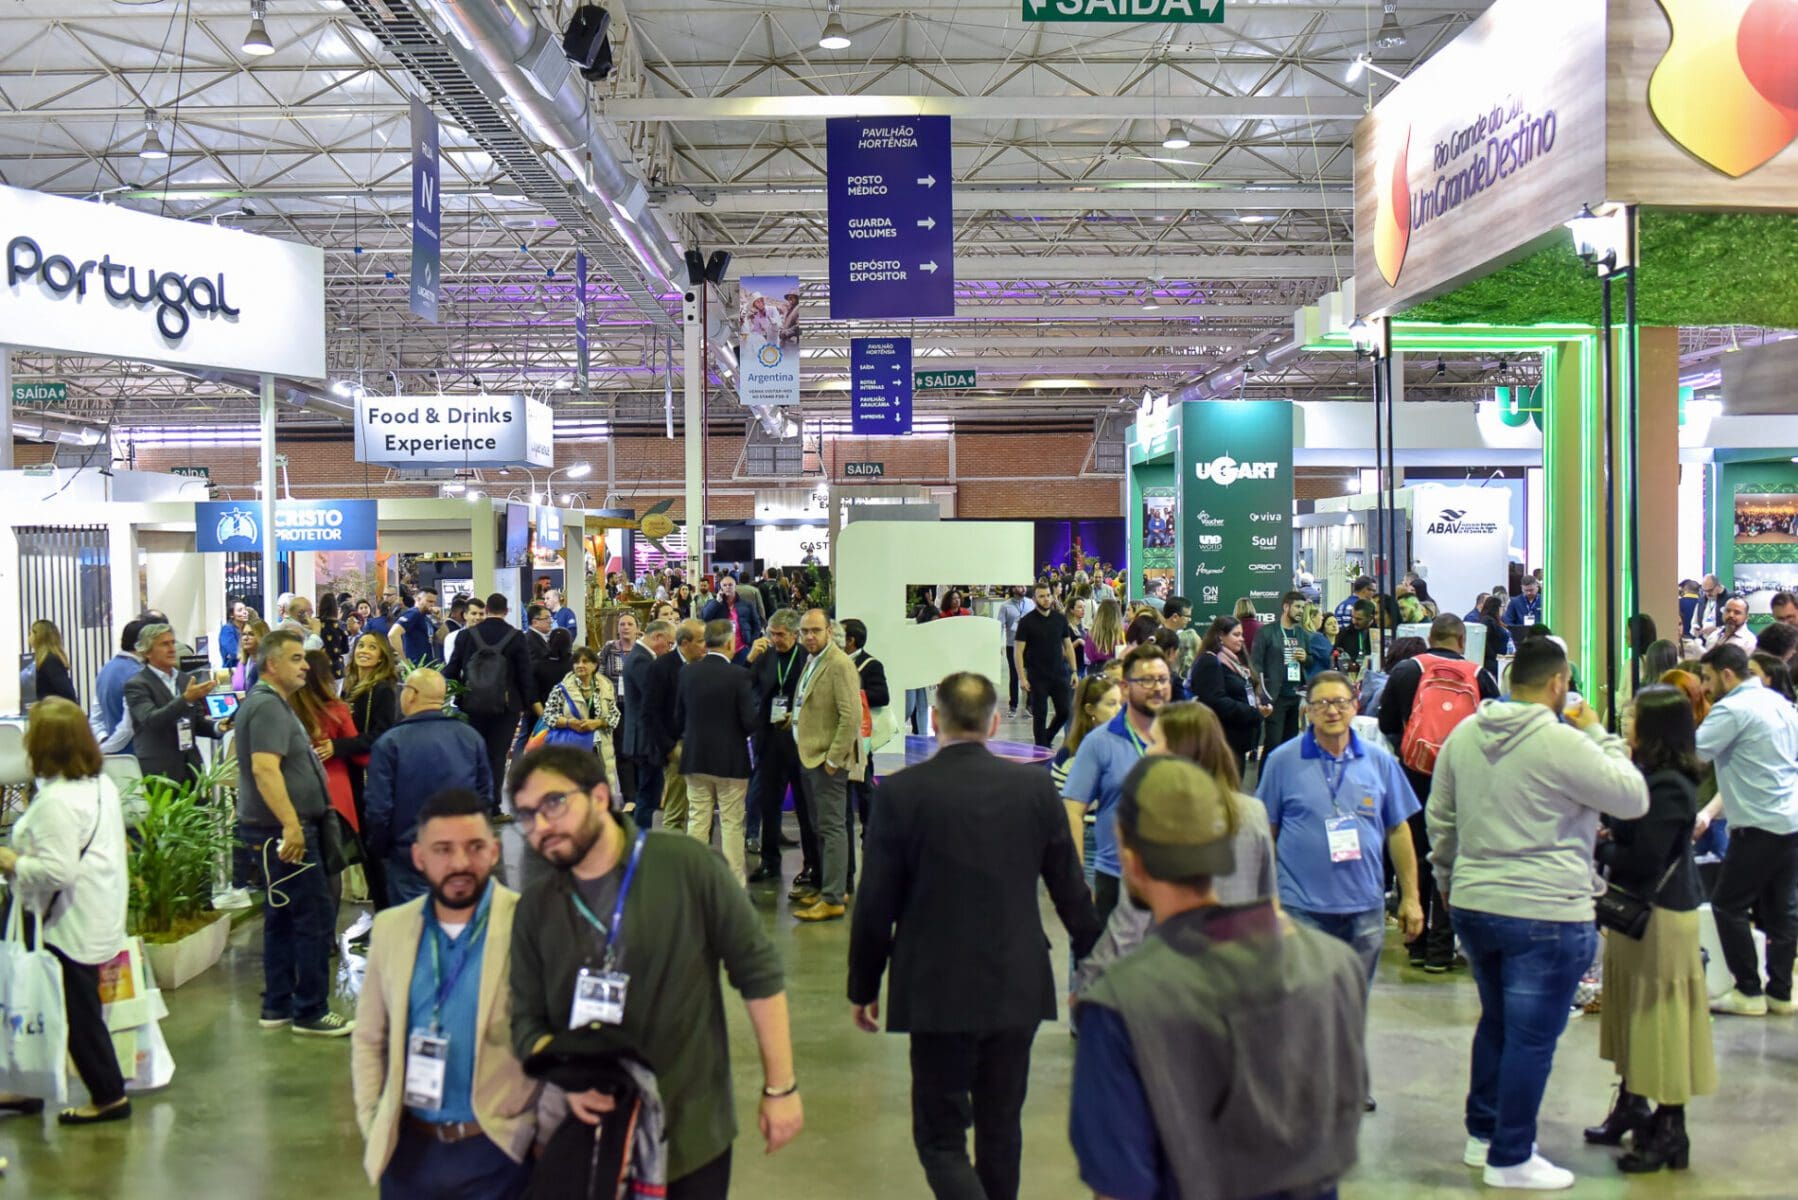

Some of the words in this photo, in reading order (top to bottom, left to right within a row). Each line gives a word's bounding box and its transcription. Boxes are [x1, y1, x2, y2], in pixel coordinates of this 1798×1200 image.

[862, 125, 914, 137] PAVILHÃO
[858, 137, 918, 149] HORTÊNSIA
[1433, 140, 1448, 171] Rio
[1451, 113, 1486, 160] Grande
[1488, 104, 1503, 134] do
[847, 175, 883, 185] POSTO
[421, 170, 434, 214] N
[847, 185, 888, 196] MÉDICO
[848, 217, 892, 228] GUARDA
[848, 228, 897, 239] VOLUMES
[849, 259, 901, 271] DEPÓSITO
[850, 271, 907, 282] EXPOSITOR
[6, 235, 240, 340] Portugal
[748, 373, 794, 384] Argentina
[925, 373, 967, 387] SAÍDA
[16, 387, 58, 399] SAÍDA
[368, 407, 419, 424] Food
[425, 408, 440, 424] &
[448, 406, 513, 424] Drinks
[385, 434, 496, 456] Experience
[847, 463, 881, 474] SAÍDA
[1195, 456, 1278, 486] UGART
[274, 508, 343, 527] CRISTO
[1260, 512, 1282, 521] viva
[1426, 521, 1462, 534] ABAV
[1252, 535, 1277, 546] Soul
[1202, 586, 1219, 595] ON
